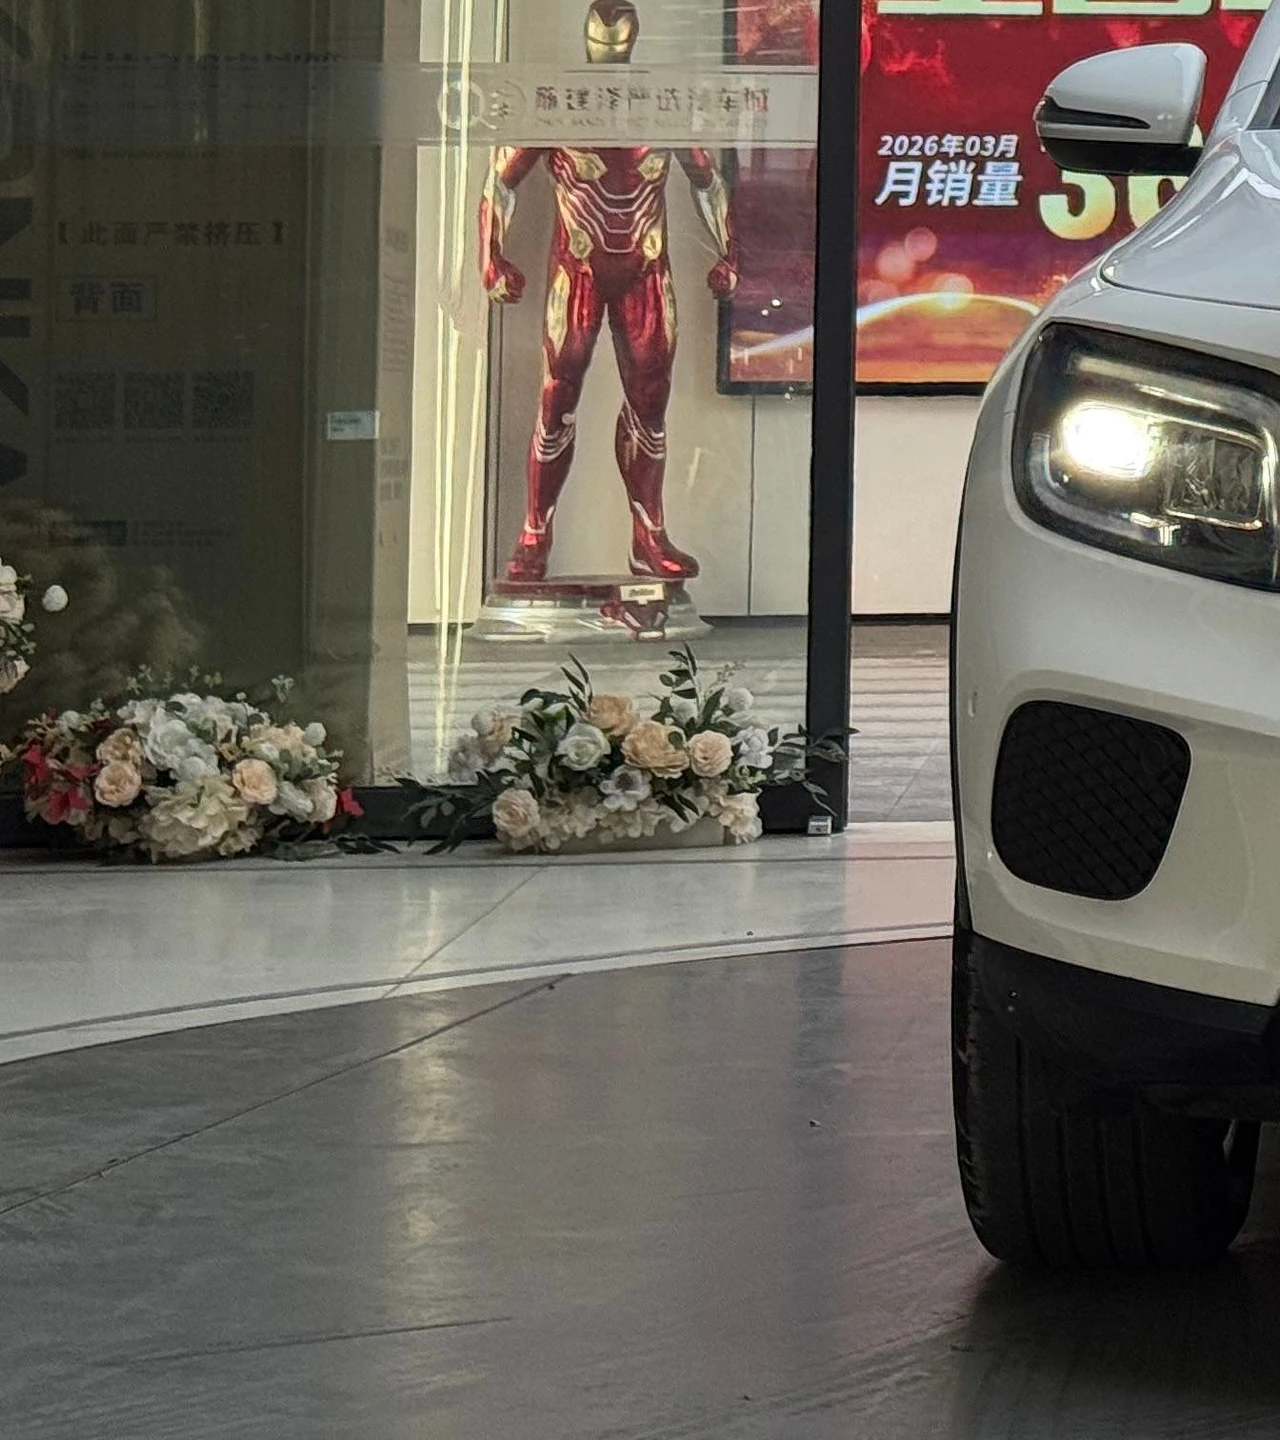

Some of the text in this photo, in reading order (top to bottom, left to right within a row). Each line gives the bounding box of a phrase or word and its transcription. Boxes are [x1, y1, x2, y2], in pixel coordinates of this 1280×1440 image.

[876, 133, 1019, 158] 2026年03月
[874, 160, 1024, 207] 月销量
[70, 280, 144, 313] 背面
